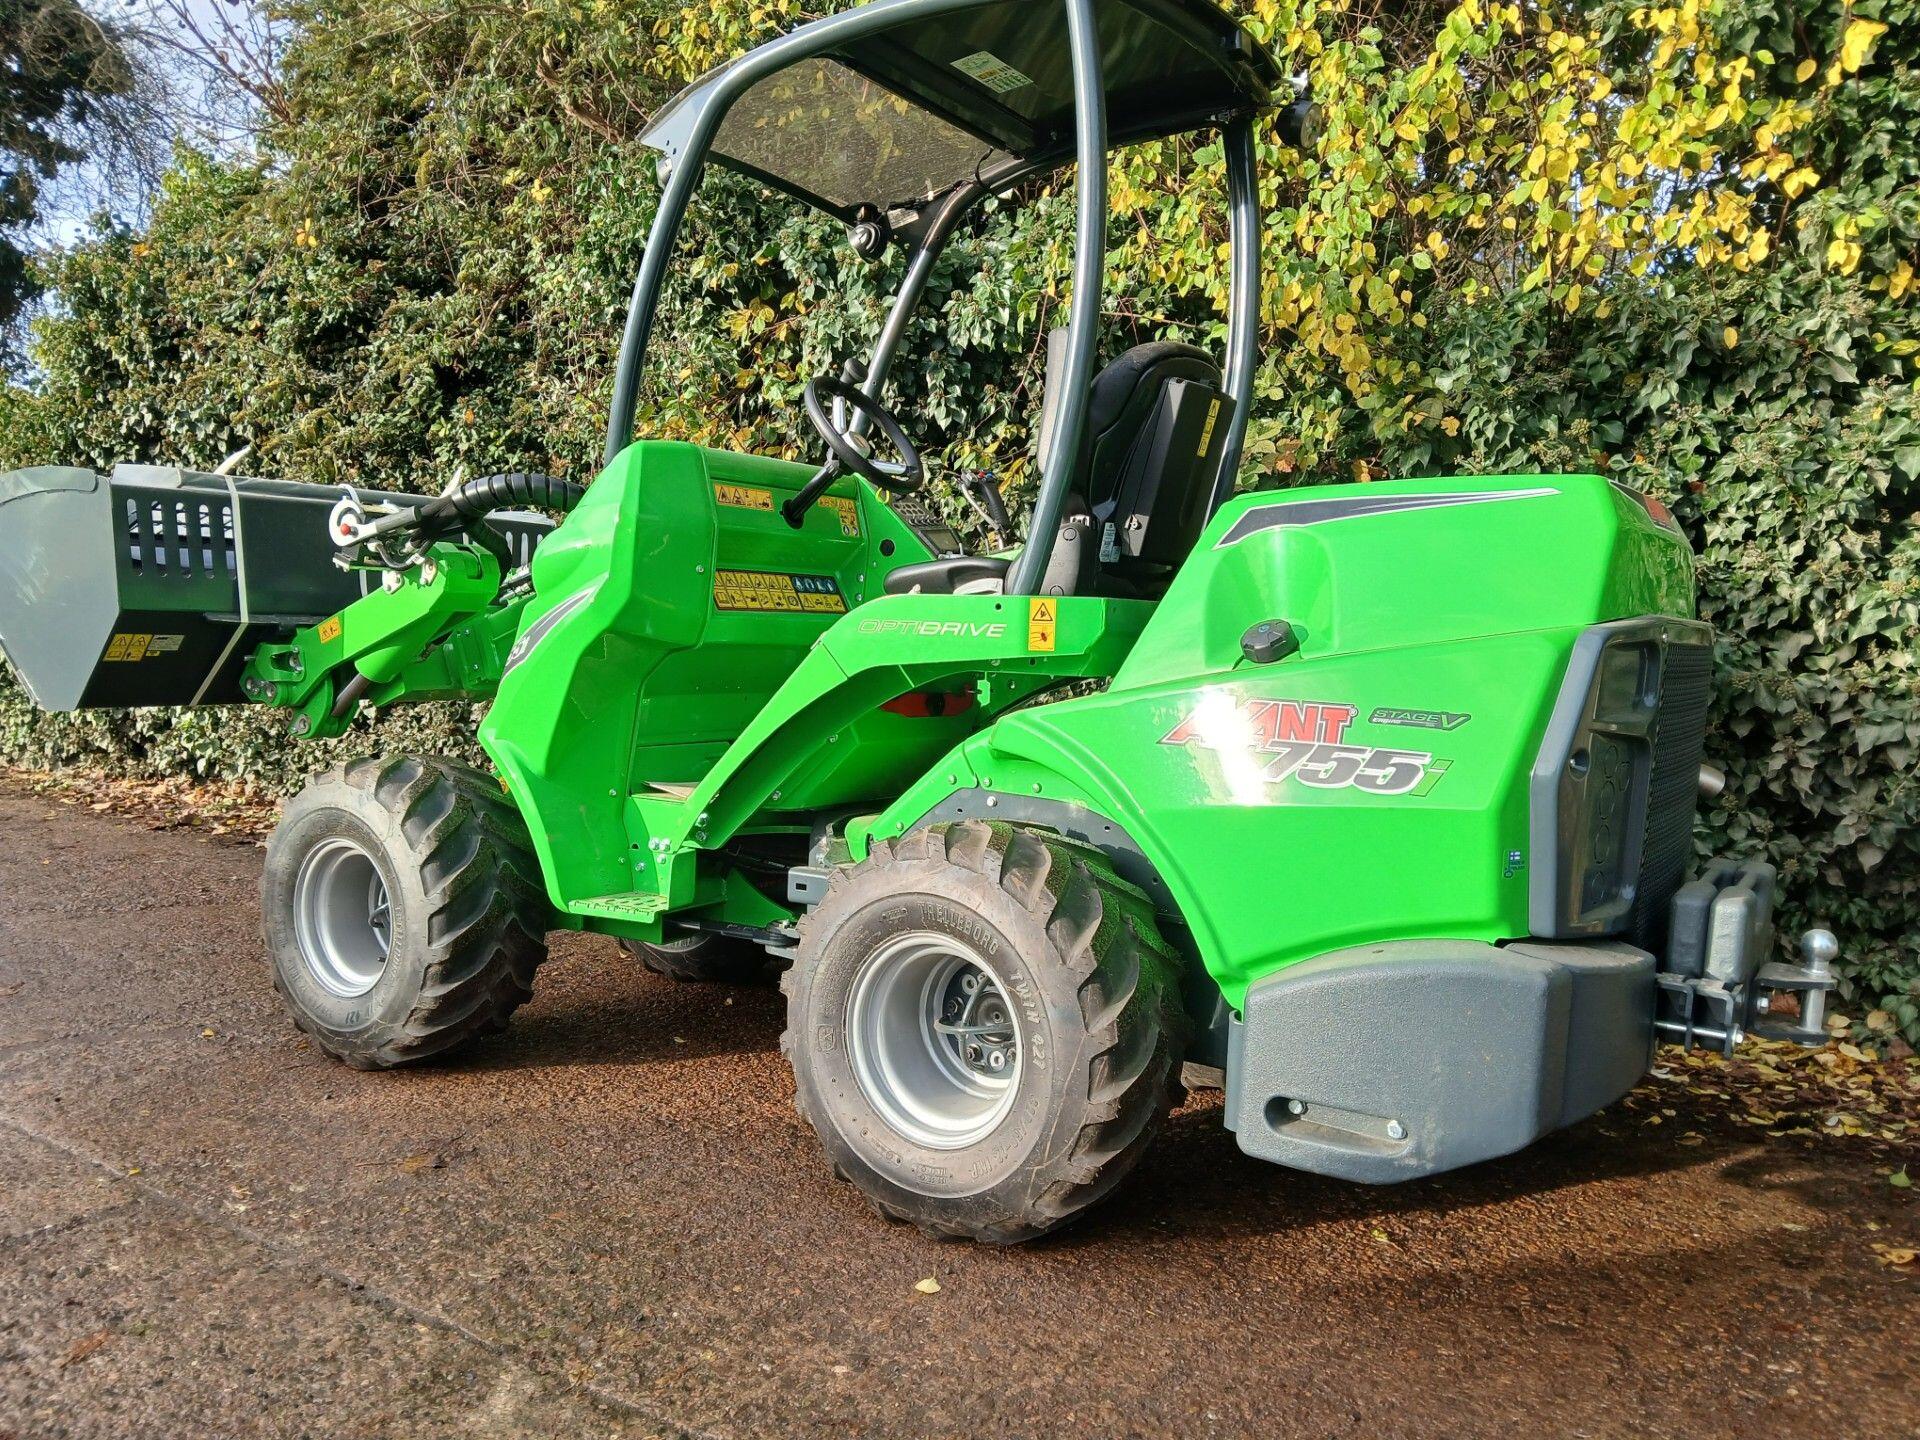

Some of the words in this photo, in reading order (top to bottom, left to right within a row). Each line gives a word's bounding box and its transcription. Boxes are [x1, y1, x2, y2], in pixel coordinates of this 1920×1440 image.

[858, 621, 1007, 637] OPTIDRIVE
[1157, 695, 1353, 745] AANT
[1375, 710, 1439, 722] STAGE
[1441, 714, 1468, 728] V
[917, 901, 999, 955] TRELLEBORG
[1010, 970, 1041, 1024] TWIN
